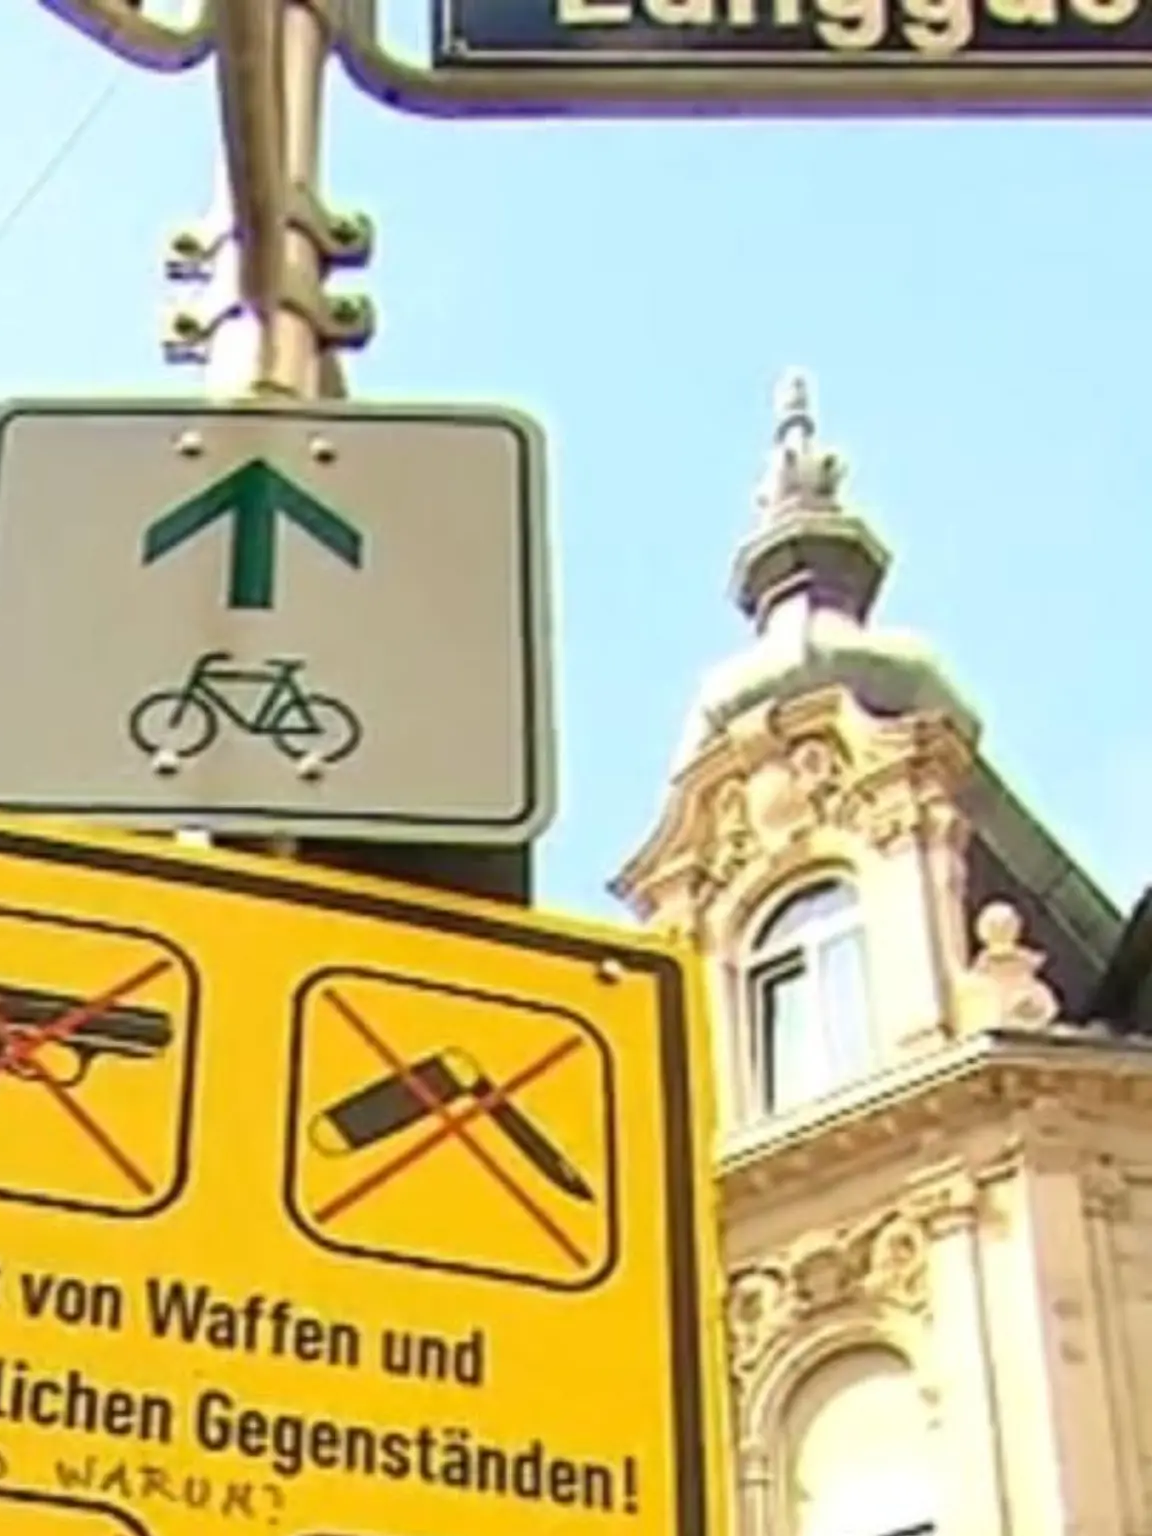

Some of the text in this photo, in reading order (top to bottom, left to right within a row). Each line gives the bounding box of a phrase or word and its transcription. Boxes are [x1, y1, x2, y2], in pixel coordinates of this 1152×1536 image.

[21, 1273, 122, 1329] von
[147, 1279, 359, 1366] Waffen
[383, 1331, 484, 1386] und
[196, 1391, 639, 1514] Gegenständen!
